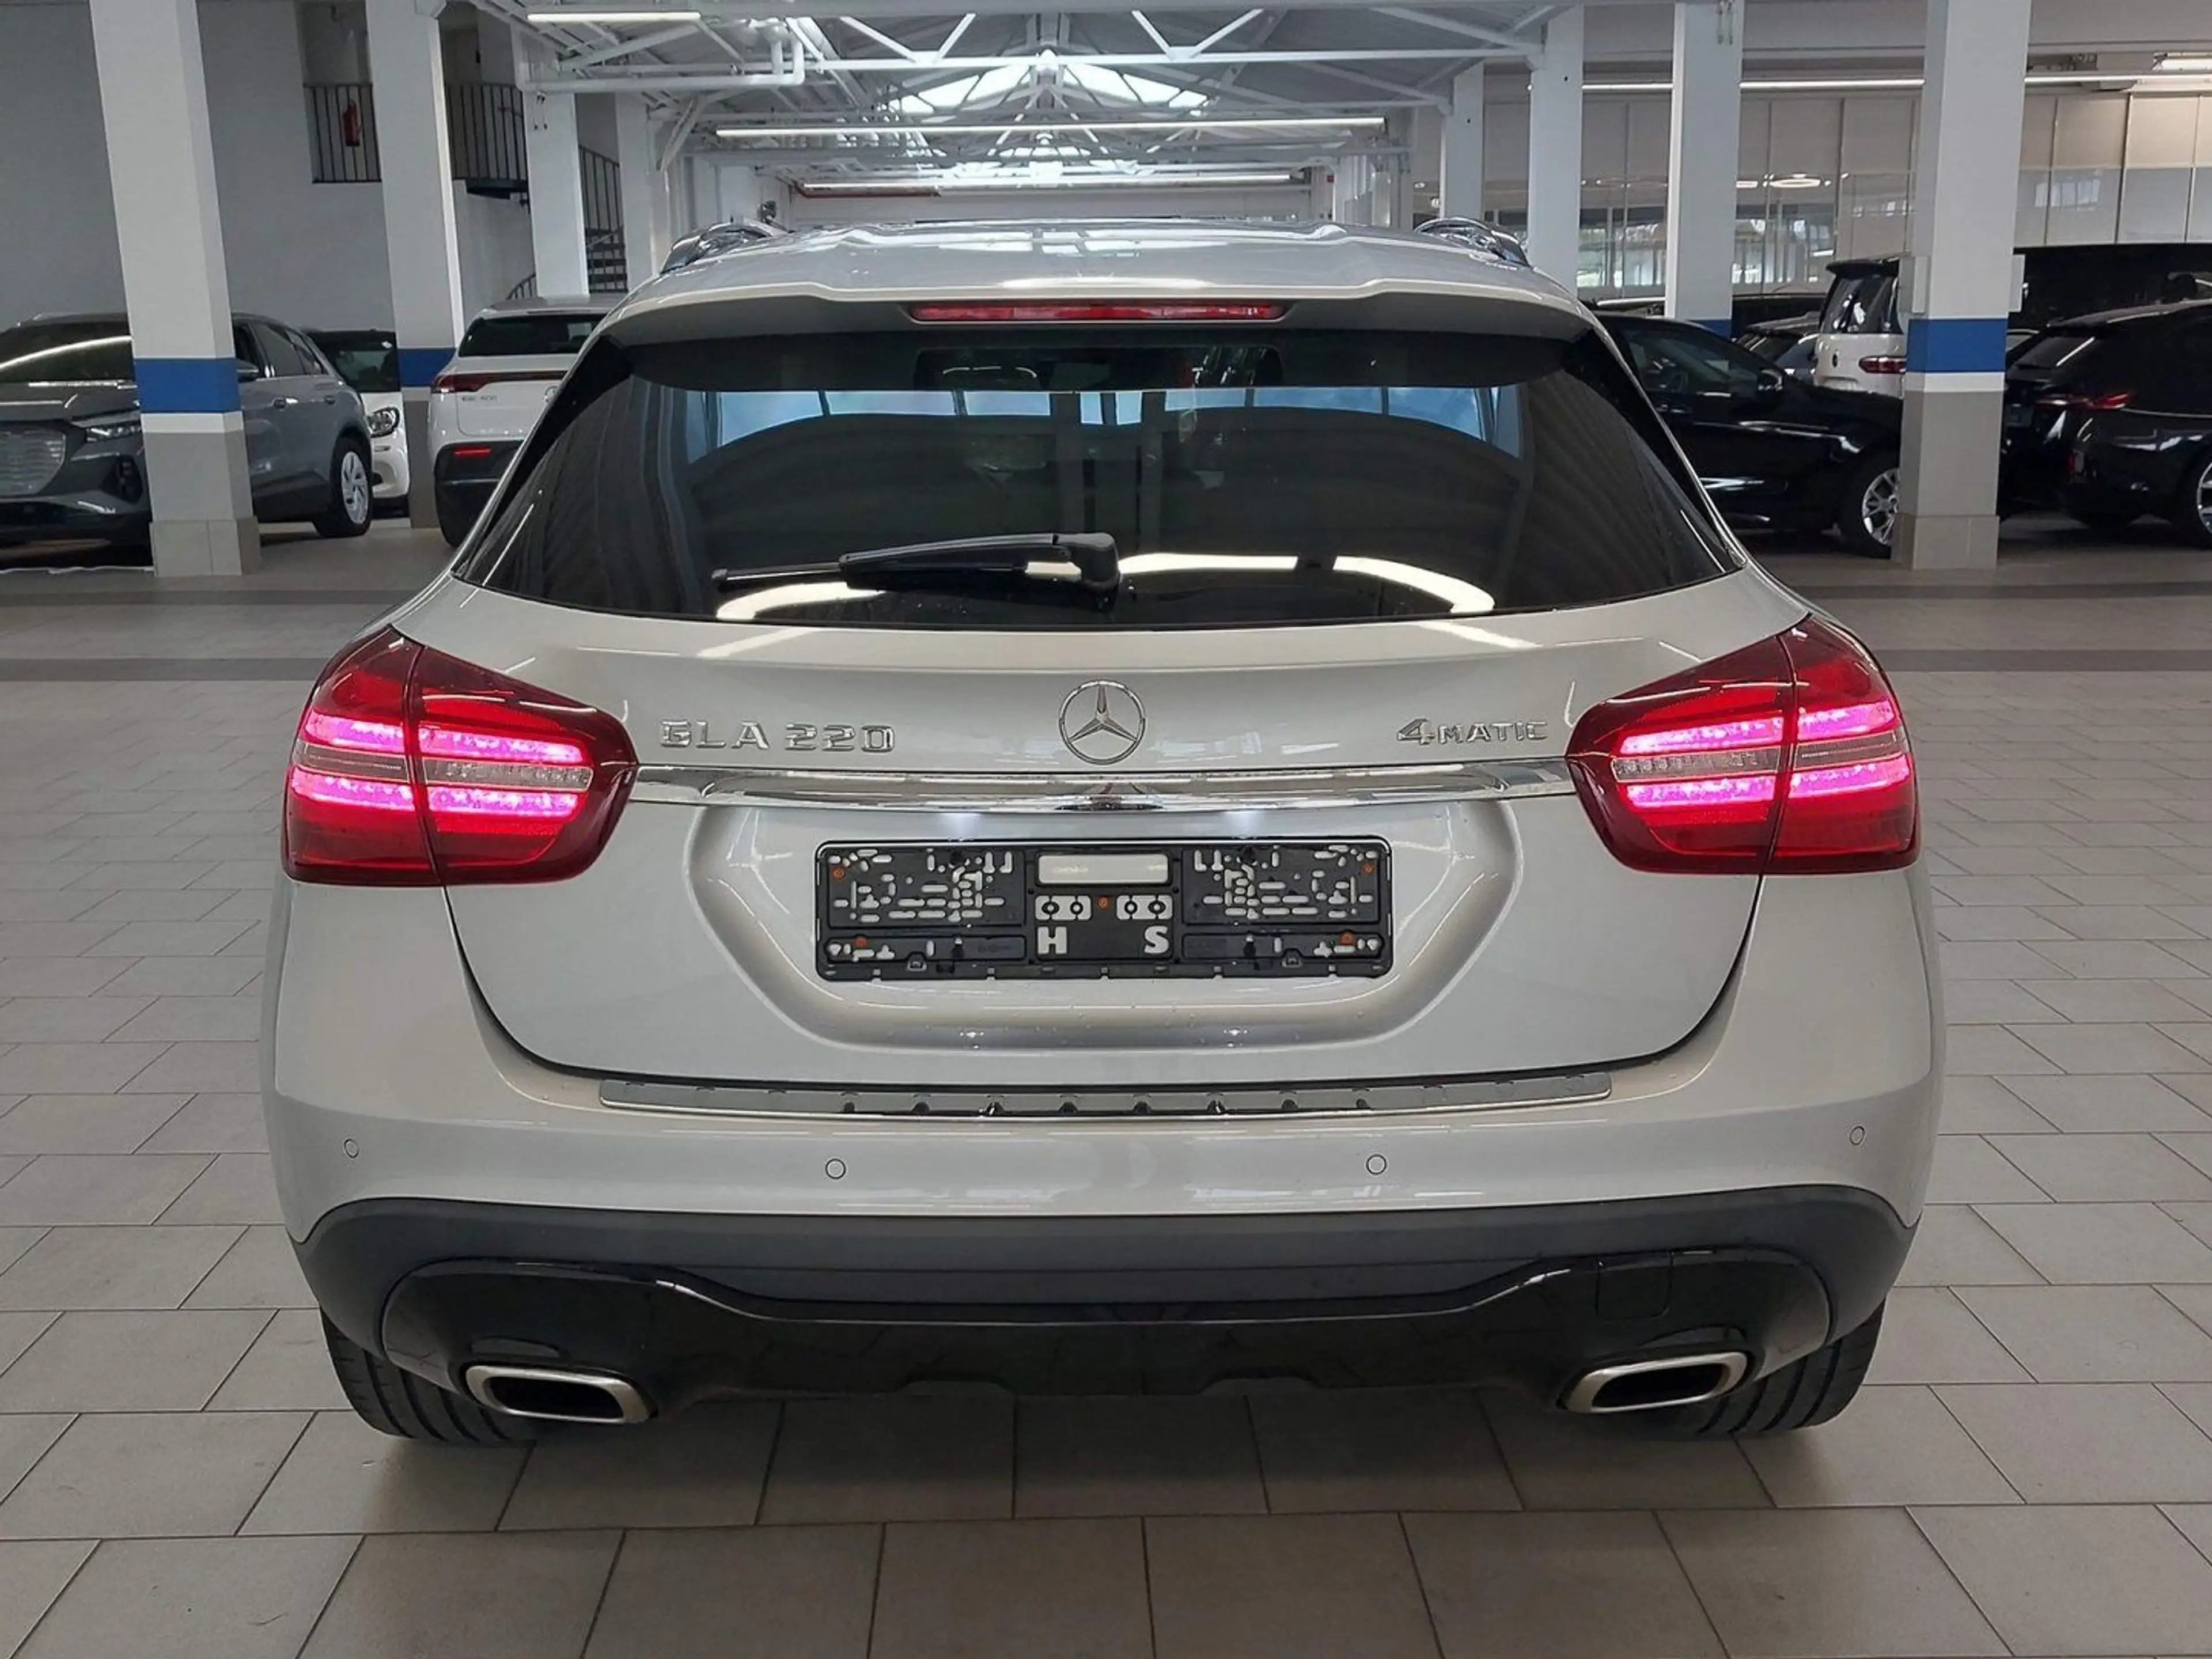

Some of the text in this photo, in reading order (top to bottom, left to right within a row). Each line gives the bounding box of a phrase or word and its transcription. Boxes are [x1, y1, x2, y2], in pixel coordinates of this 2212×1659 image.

[660, 719, 895, 753] GLA 220
[1397, 718, 1548, 745] 4MATIC
[1037, 926, 1169, 955] H S
